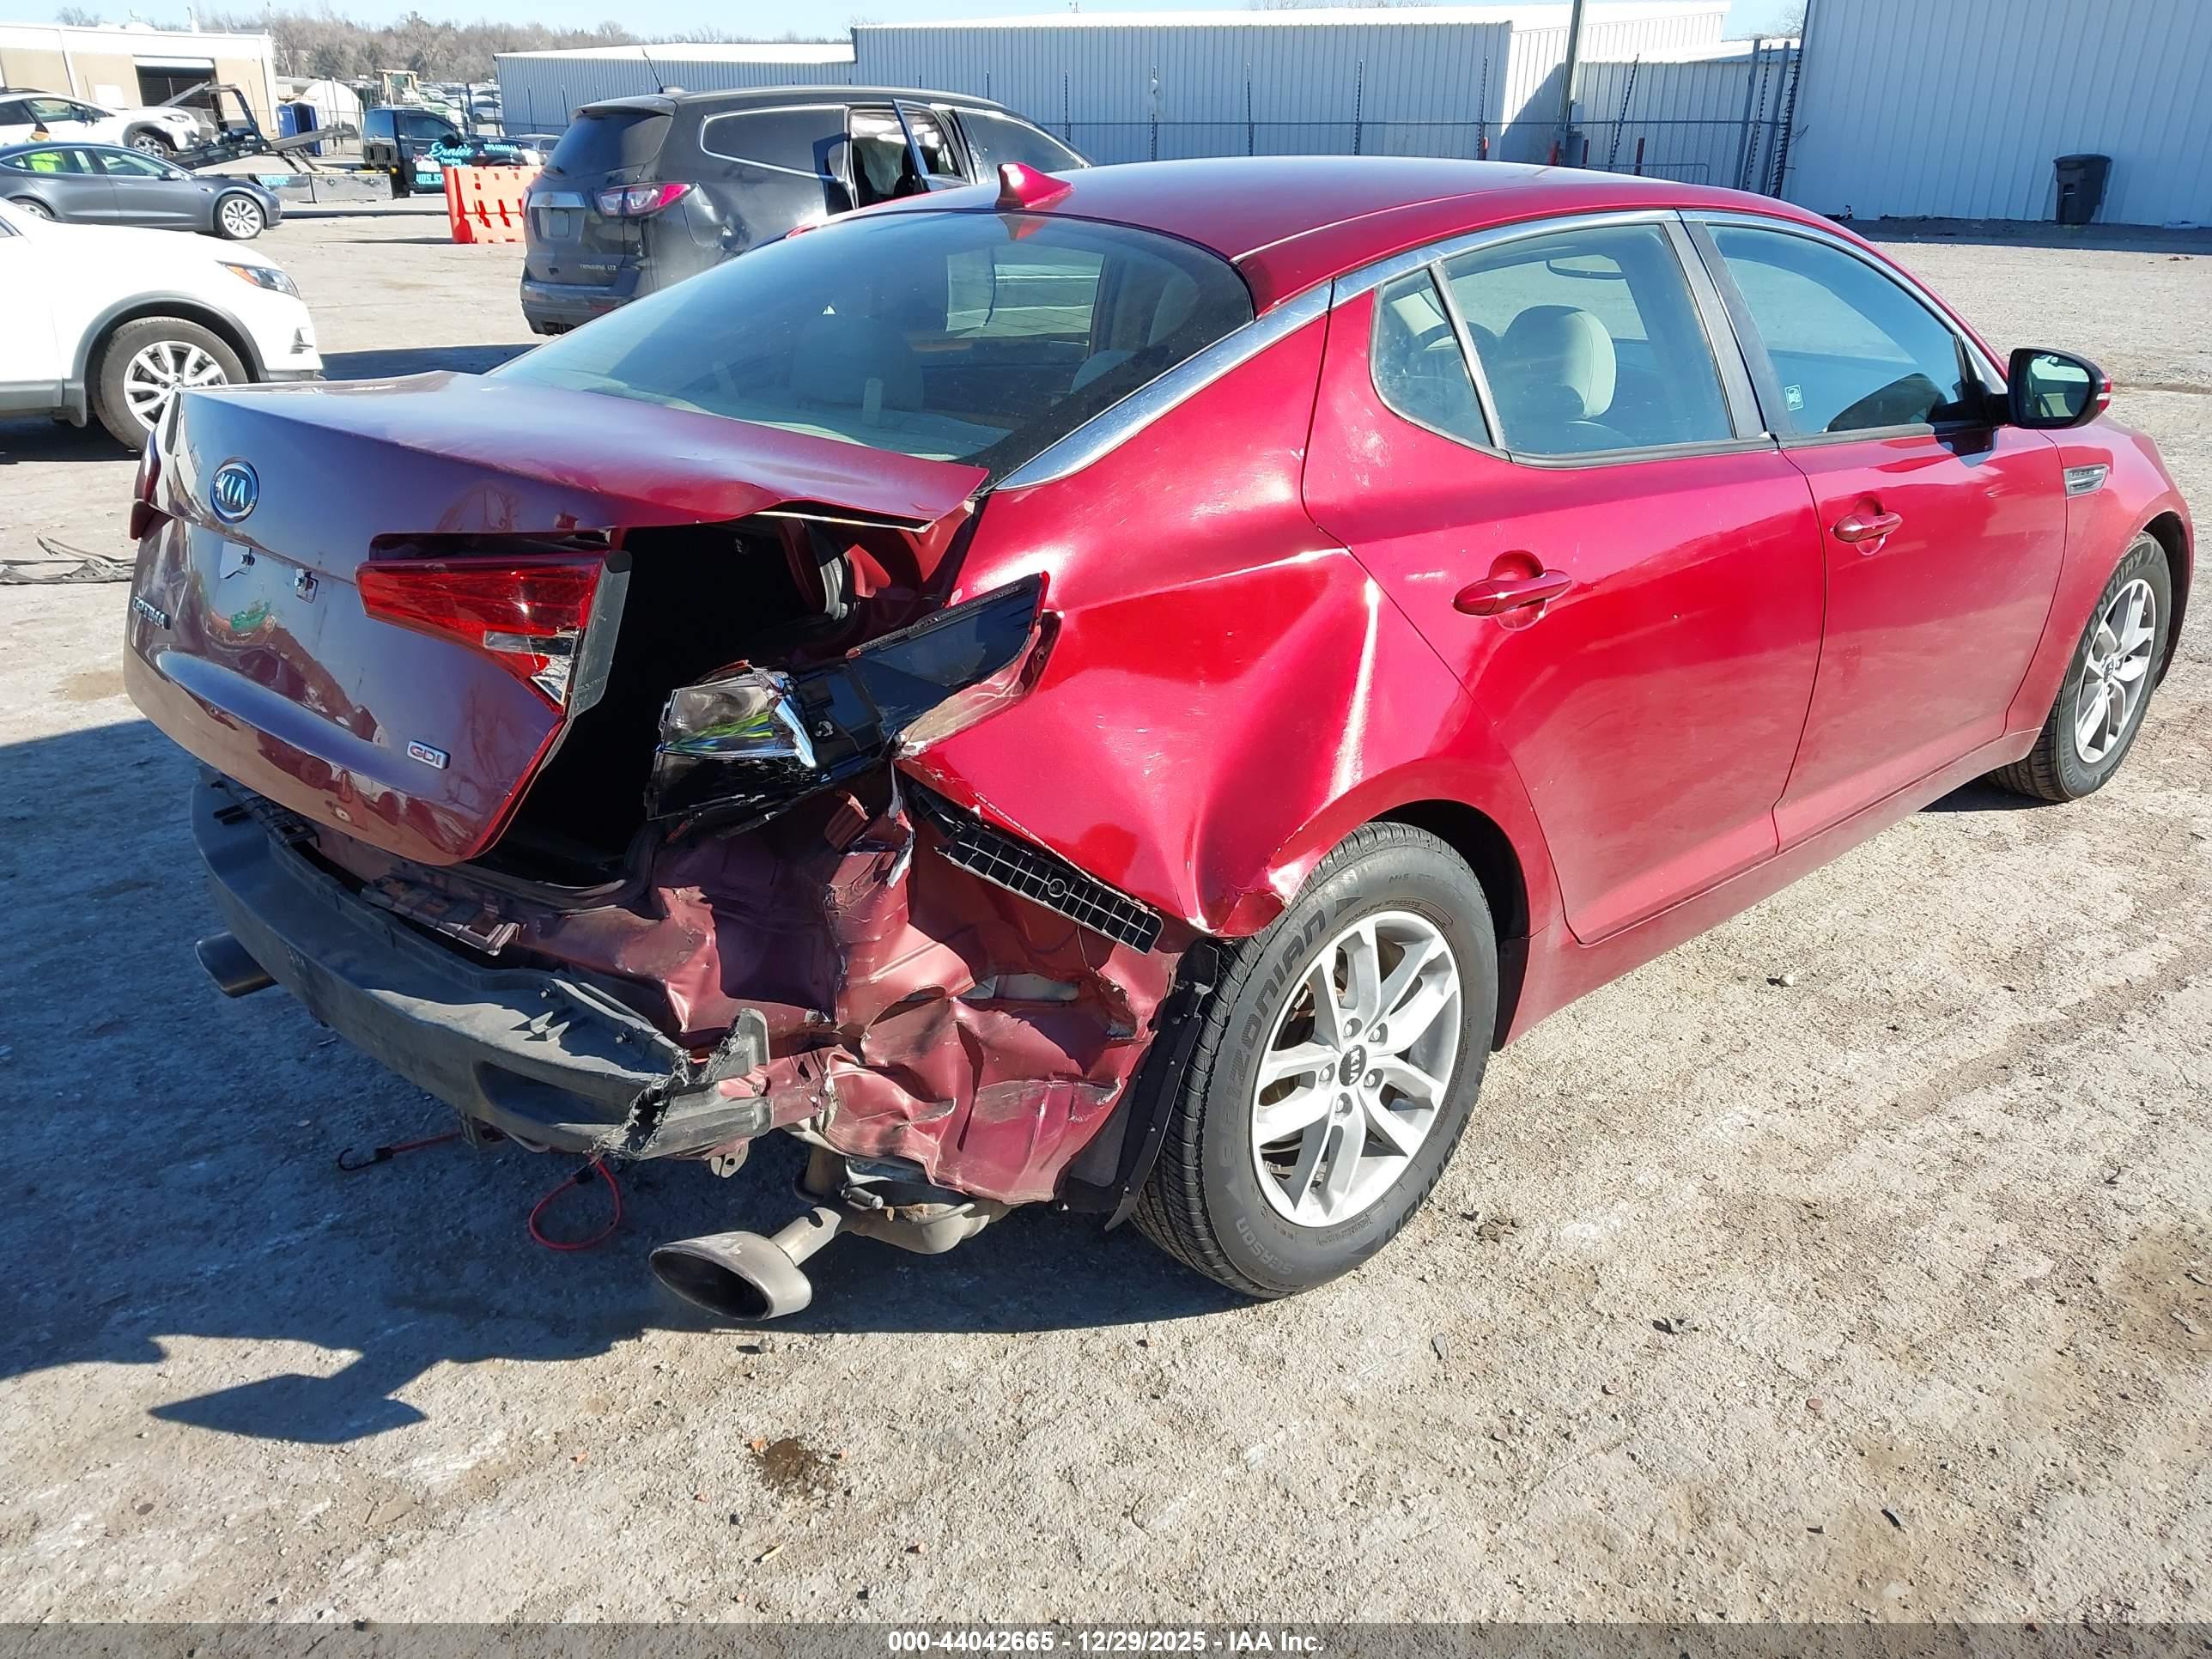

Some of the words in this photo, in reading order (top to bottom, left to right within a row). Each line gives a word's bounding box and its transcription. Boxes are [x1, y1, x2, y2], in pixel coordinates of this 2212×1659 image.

[429, 141, 473, 157] Ernie's
[440, 157, 462, 166] Towing
[216, 472, 246, 508] KIA
[410, 744, 441, 765] GDI
[1349, 1048, 1360, 1085] KIA
